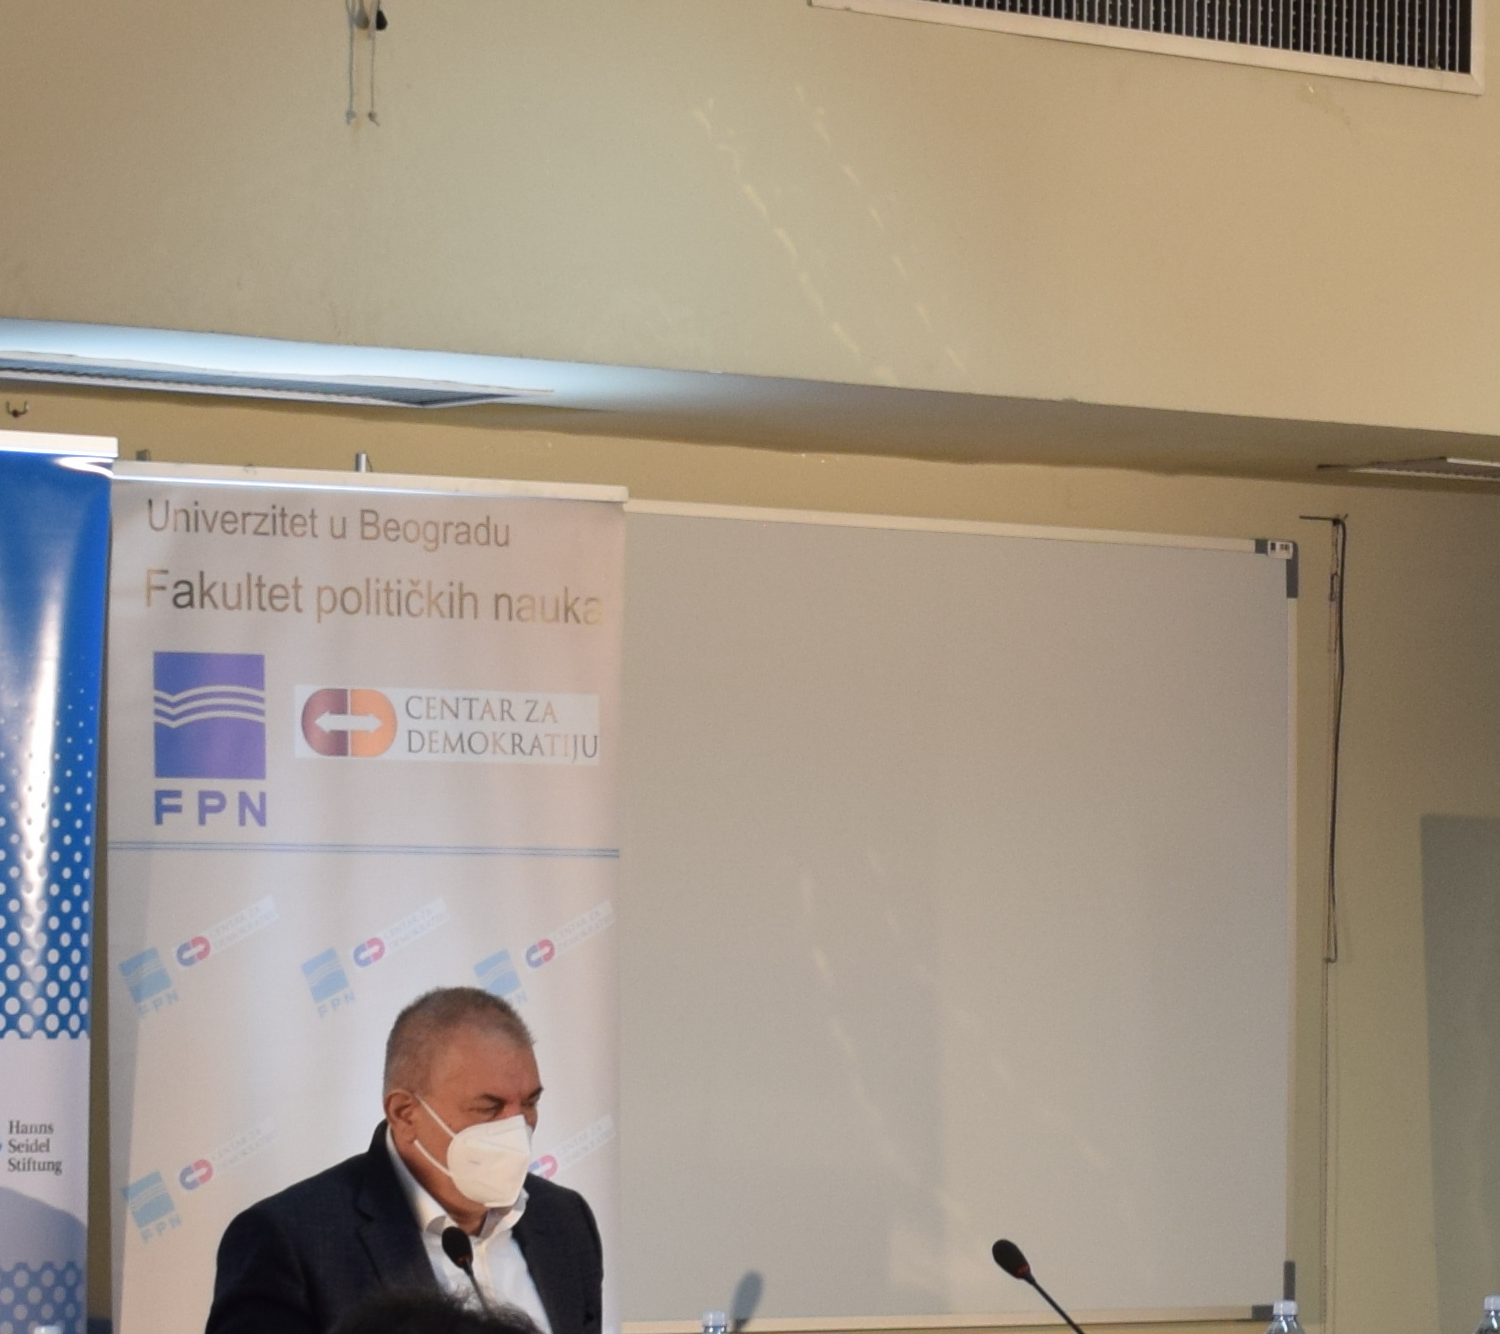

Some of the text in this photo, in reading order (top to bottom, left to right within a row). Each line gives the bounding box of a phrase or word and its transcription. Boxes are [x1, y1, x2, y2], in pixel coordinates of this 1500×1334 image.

[147, 498, 511, 553] Univerzitet u Beogradu
[144, 568, 603, 625] Fakultet političkih nauka
[404, 694, 558, 724] CENTAR ZA
[406, 730, 599, 764] DEMOKRATIJU
[154, 788, 268, 828] FPN
[8, 1120, 55, 1135] Hanns
[7, 1138, 50, 1154] Seidel
[7, 1157, 63, 1176] Stiftung
